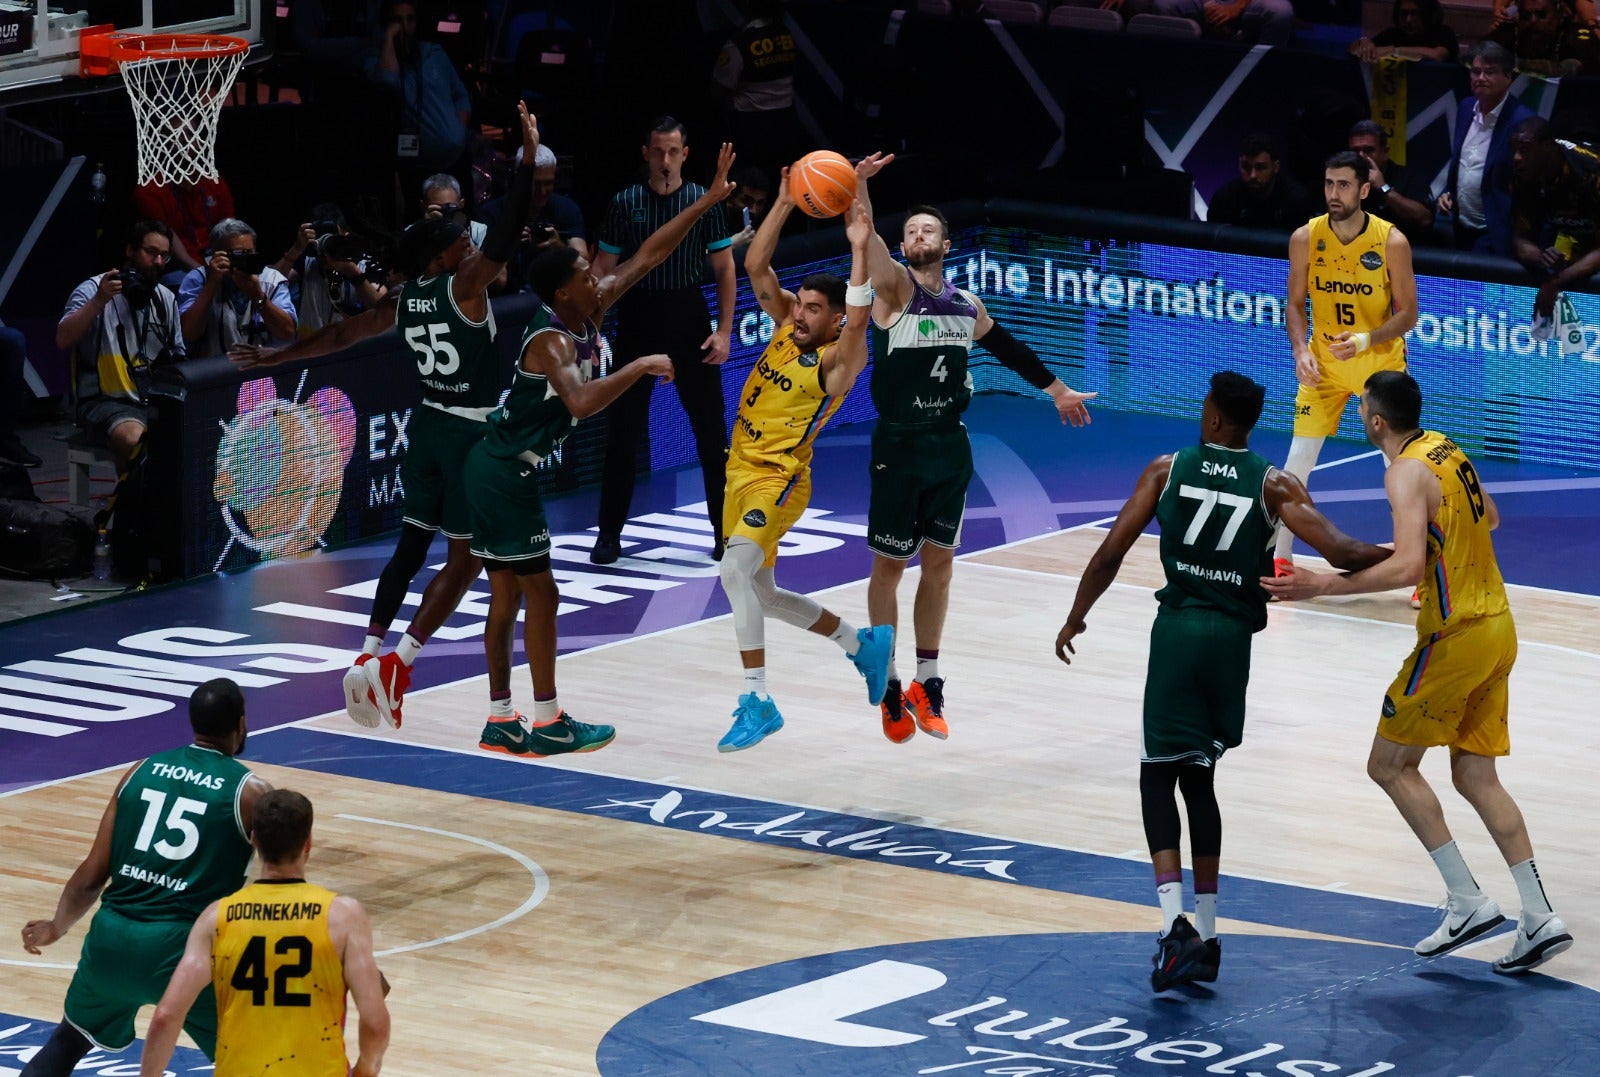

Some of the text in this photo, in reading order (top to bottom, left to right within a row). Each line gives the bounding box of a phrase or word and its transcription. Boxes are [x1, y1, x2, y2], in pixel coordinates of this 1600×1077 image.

[966, 249, 1030, 296] the
[1044, 258, 1287, 328] Internation
[1315, 276, 1373, 296] Lenovo
[1335, 302, 1356, 326] 15
[937, 329, 968, 340] Unicaja
[404, 322, 461, 376] 55
[929, 355, 949, 383] 4
[1201, 461, 1239, 480] SIMA
[1456, 460, 1485, 525] 19
[1179, 484, 1254, 551] 77
[151, 763, 225, 791] THOMAS
[133, 788, 208, 861] 15
[119, 864, 188, 892] ENAHAVÍS
[226, 903, 322, 923] DOORNEKAMP
[230, 936, 313, 1007] 42
